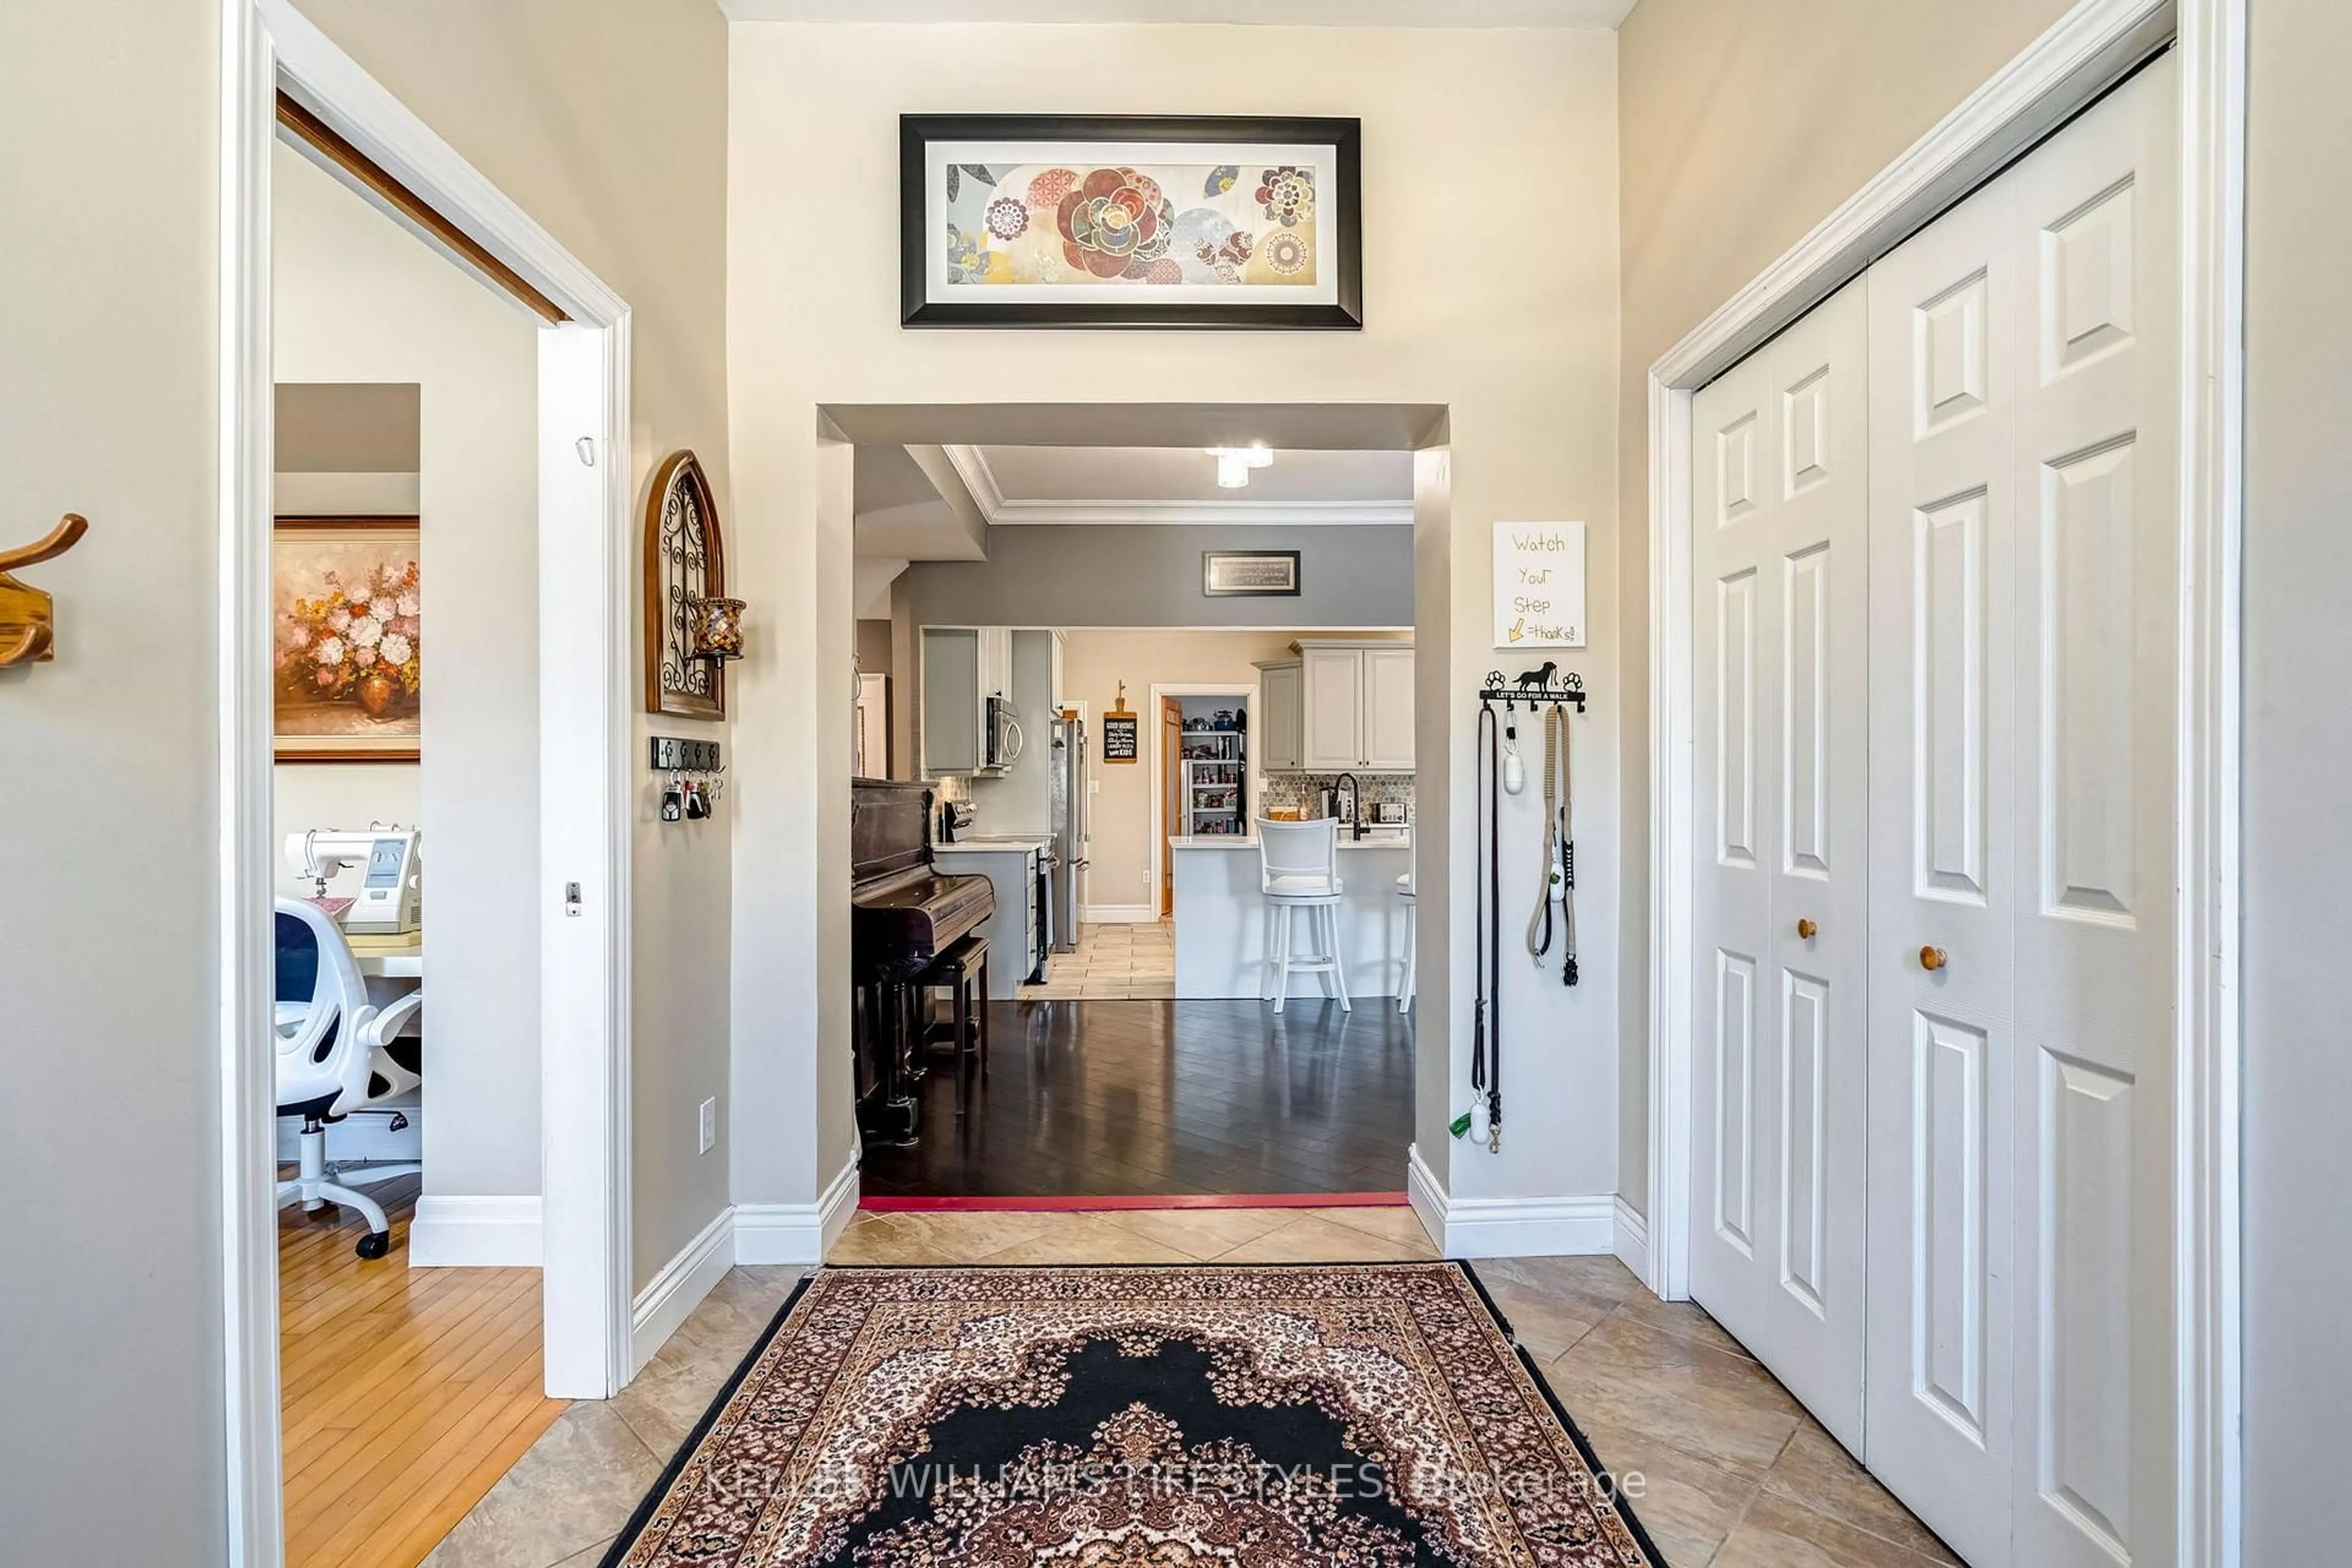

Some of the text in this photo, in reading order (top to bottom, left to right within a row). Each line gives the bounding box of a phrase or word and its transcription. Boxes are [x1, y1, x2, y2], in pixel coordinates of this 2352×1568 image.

[1512, 532, 1566, 552] Watch
[1519, 568, 1552, 584] Your
[1513, 597, 1551, 615] Step
